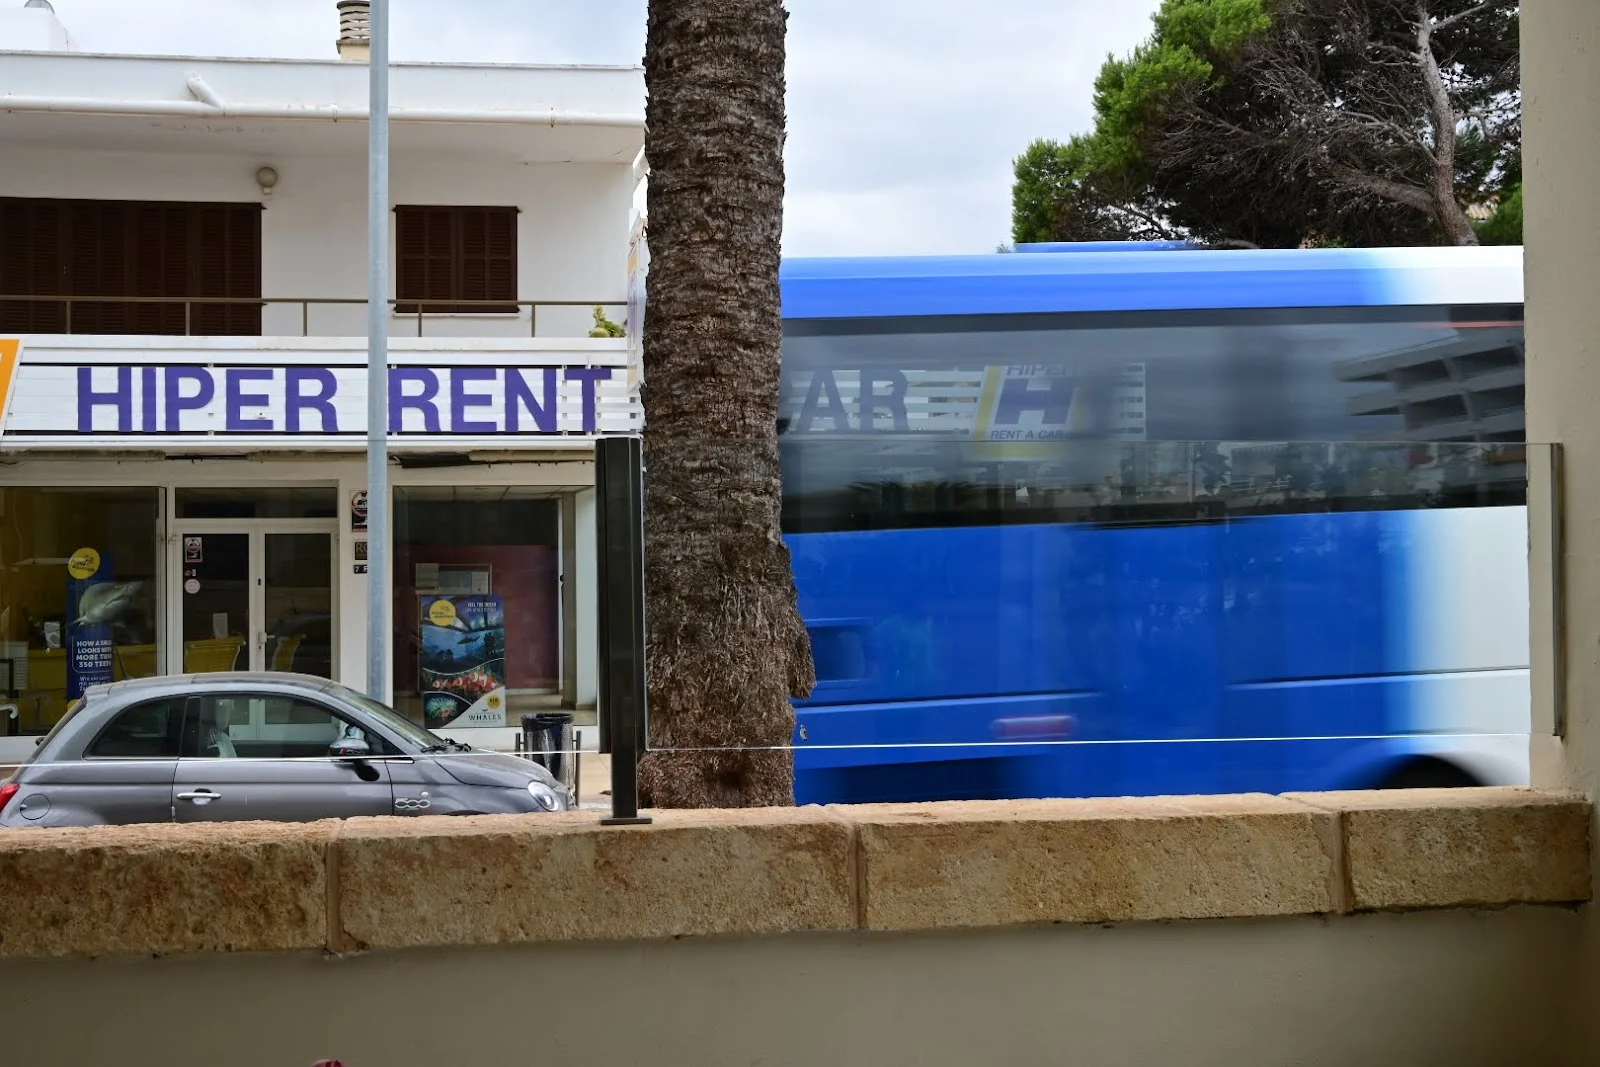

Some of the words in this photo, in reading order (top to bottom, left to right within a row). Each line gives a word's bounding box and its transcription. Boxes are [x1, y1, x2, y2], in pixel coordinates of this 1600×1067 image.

[77, 367, 339, 432] HIPER
[388, 367, 611, 432] RENT
[783, 368, 911, 431] AR
[990, 430, 1024, 440] RENT
[1025, 430, 1035, 440] A
[1038, 430, 1065, 440] CAR
[468, 713, 502, 721] WHALES
[395, 797, 431, 809] 500
